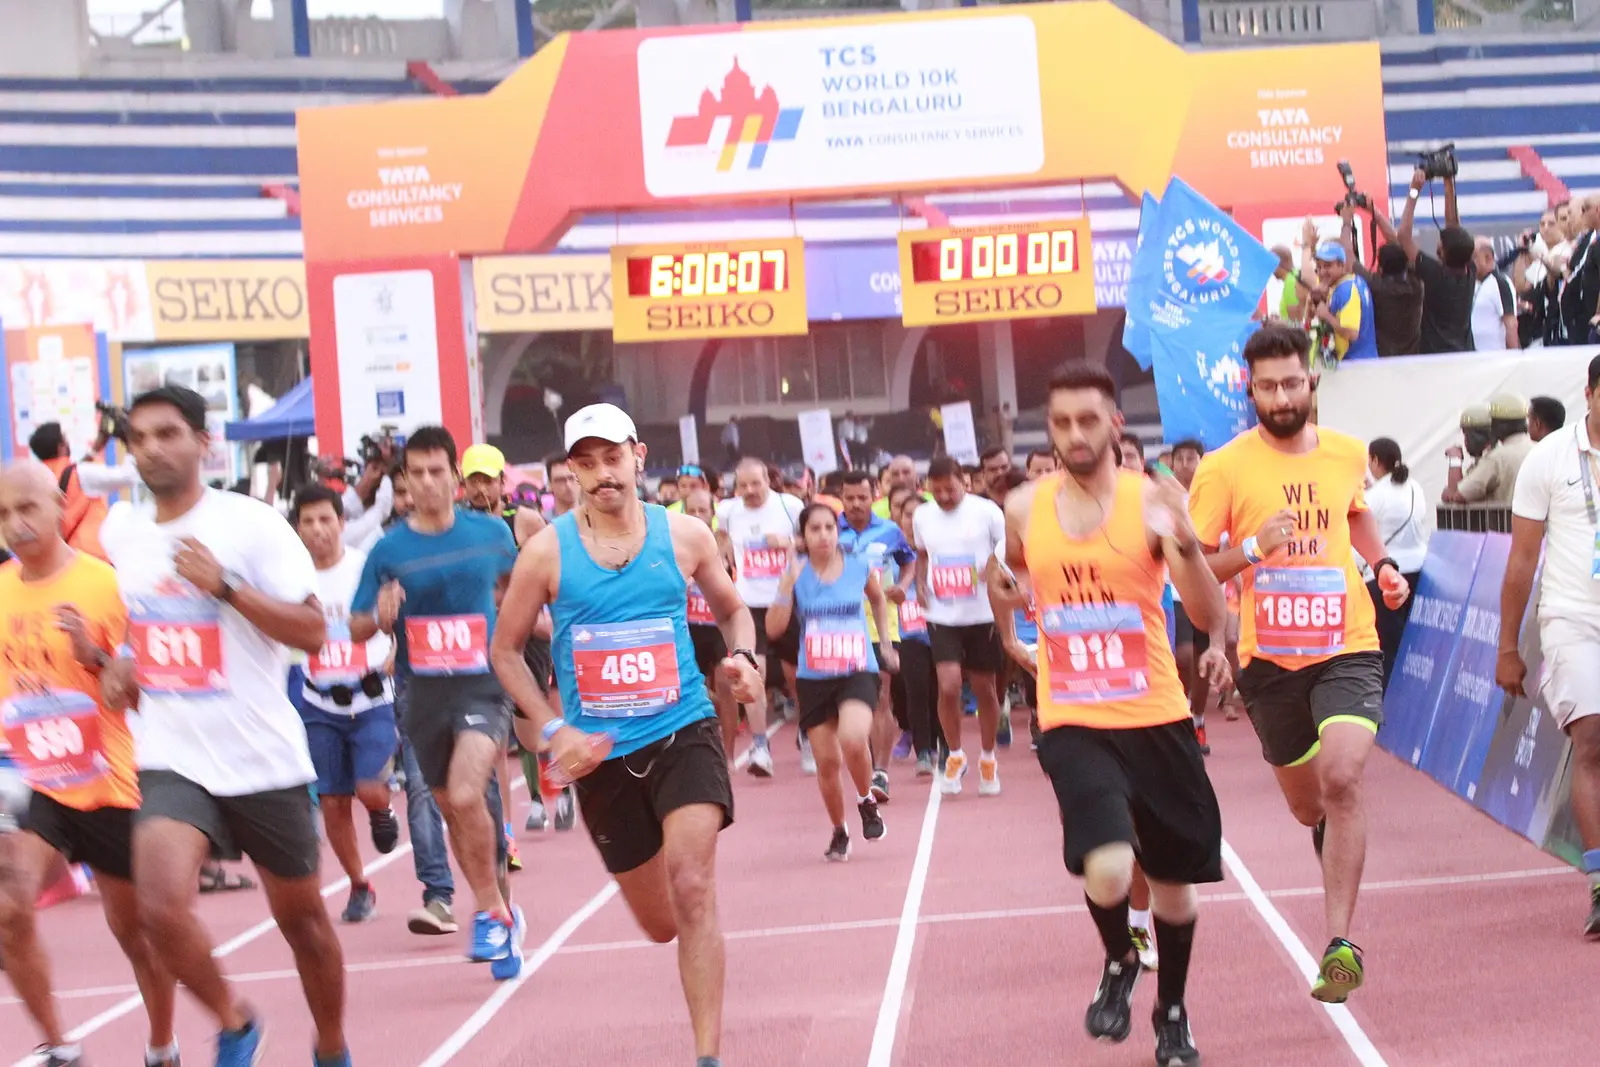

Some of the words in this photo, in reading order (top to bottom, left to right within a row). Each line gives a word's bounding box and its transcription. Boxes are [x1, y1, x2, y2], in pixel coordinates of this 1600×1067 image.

[819, 44, 877, 68] TCS
[821, 71, 911, 93] WORLD
[919, 68, 959, 88] 10K
[822, 93, 963, 119] BENGALURU
[1257, 108, 1310, 127] TATA
[826, 135, 863, 148] TATA
[868, 127, 961, 146] CONSULTANCY
[965, 124, 1024, 141] SERVICES
[1226, 125, 1342, 149] CONSULTANCY
[1250, 147, 1324, 168] SERVICES
[377, 165, 431, 185] TATA
[346, 181, 462, 209] CONSULTANCY
[369, 204, 443, 228] SERVICES
[1092, 241, 1132, 261] ATA
[650, 249, 785, 298] 6:00:07
[155, 275, 304, 322] SEIKO
[934, 283, 1063, 317] SEIKO
[646, 299, 775, 331] SEIKO
[1282, 482, 1319, 505] WE
[1296, 508, 1330, 531] UN
[1061, 561, 1099, 584] WE
[1262, 595, 1342, 628] 18665
[146, 624, 203, 668] 611
[601, 651, 656, 685] 469
